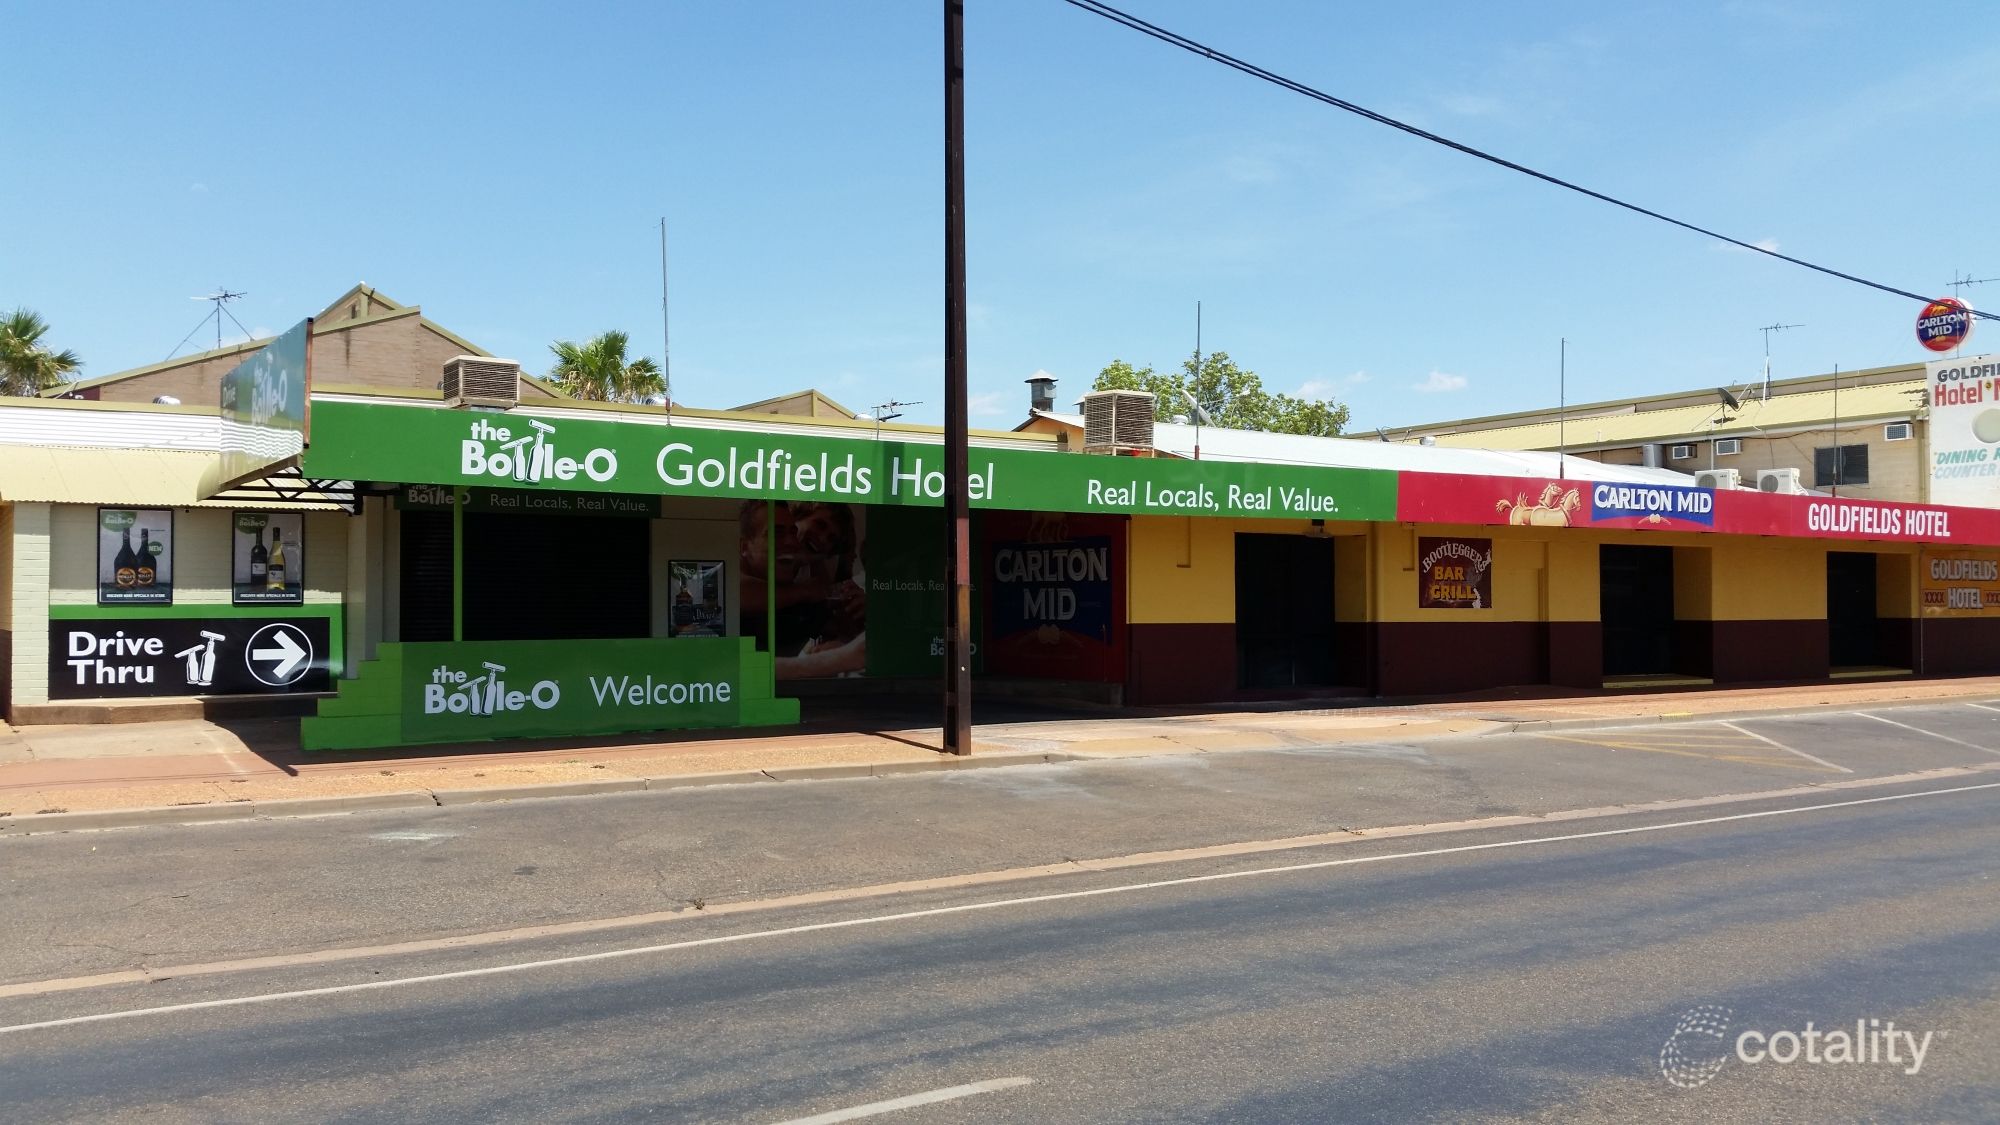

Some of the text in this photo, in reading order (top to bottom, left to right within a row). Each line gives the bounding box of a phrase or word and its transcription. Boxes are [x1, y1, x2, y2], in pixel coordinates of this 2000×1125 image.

[1918, 311, 1968, 329] CARLTON
[1928, 325, 1952, 337] MID
[1934, 380, 1983, 407] Hotel
[471, 419, 512, 442] the
[1936, 448, 1988, 465] DINING
[656, 442, 872, 496] Goldfields
[891, 456, 994, 500] Hoel
[1935, 463, 1998, 479] COUNTER
[490, 493, 520, 508] Real
[525, 495, 572, 510] Locals,
[577, 498, 605, 511] Real
[610, 498, 650, 513] Value.
[1087, 479, 1340, 513] Real Locals, Real Value.
[1593, 485, 1712, 514] CARLTON MID
[1808, 502, 1951, 537] GOLDFIELDS HOTEL
[994, 547, 1109, 583] CARLTON
[1434, 566, 1466, 580] BAR
[1930, 559, 1998, 581] GOLDFIELDS
[872, 579, 945, 592] Real Locals, Rea
[1431, 584, 1478, 600] GRILL
[1023, 587, 1077, 621] MID
[1924, 591, 1945, 603] XXXX
[1947, 587, 1984, 609] HOTEL
[67, 631, 164, 657] Drive
[67, 659, 155, 685] Thru
[432, 665, 467, 684] the
[590, 675, 731, 707] Welcome
